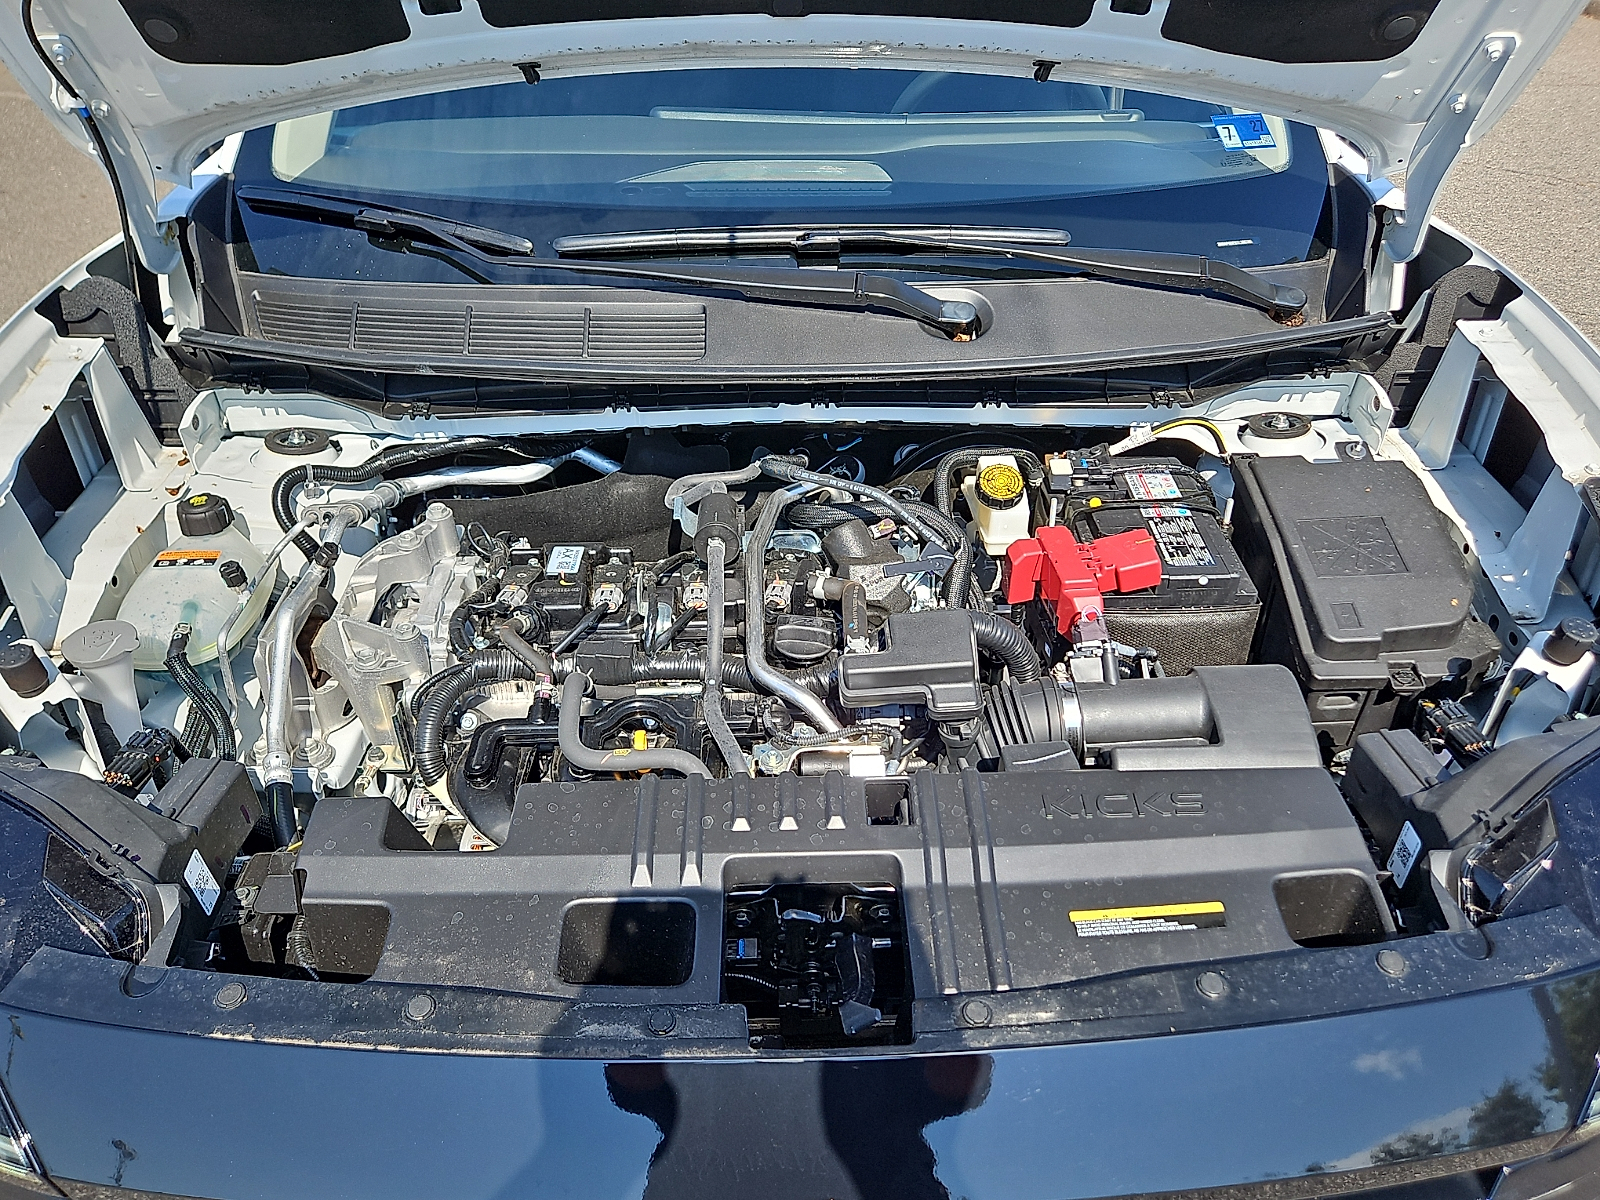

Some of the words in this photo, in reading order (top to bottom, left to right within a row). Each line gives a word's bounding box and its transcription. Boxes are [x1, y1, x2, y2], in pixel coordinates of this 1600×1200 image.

[1222, 126, 1232, 141] 7
[1249, 120, 1264, 132] 27
[1041, 791, 1209, 819] KICKS
